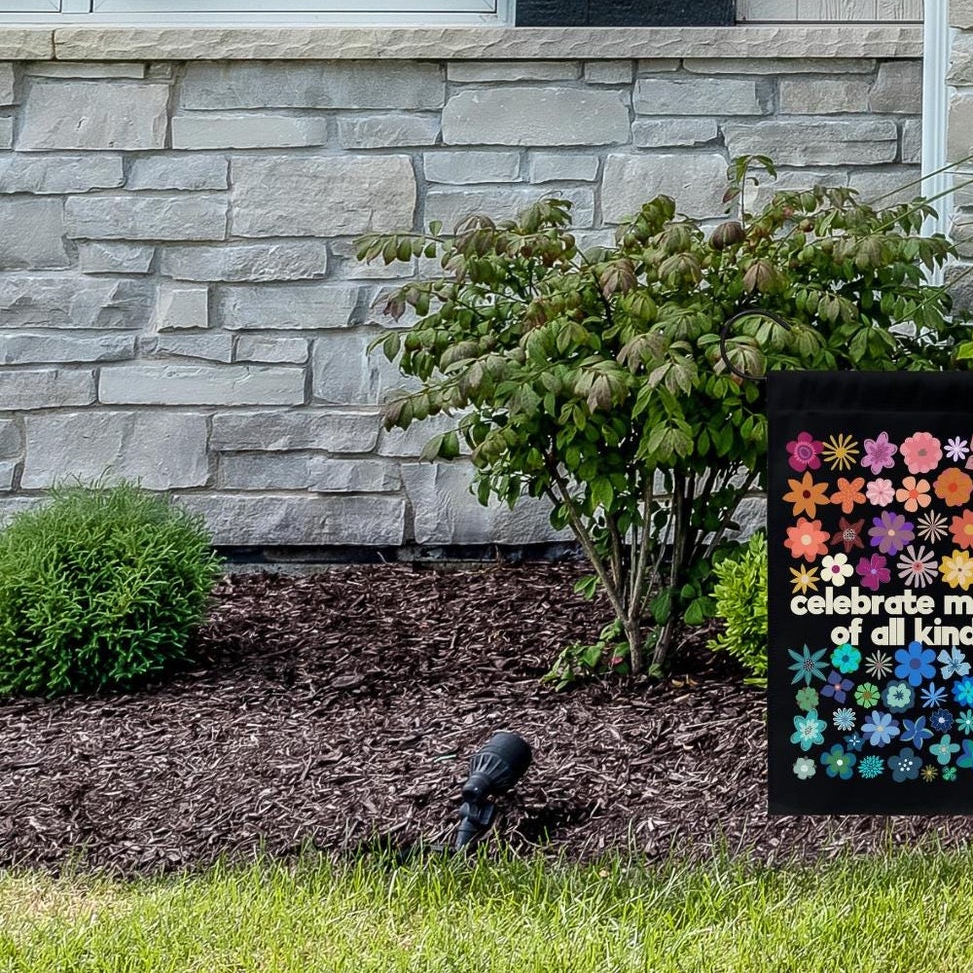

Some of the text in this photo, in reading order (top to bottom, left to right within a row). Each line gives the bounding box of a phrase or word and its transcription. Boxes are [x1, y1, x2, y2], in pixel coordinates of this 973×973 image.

[790, 587, 935, 615] celebrate
[830, 618, 863, 646] of
[870, 618, 905, 646] all
